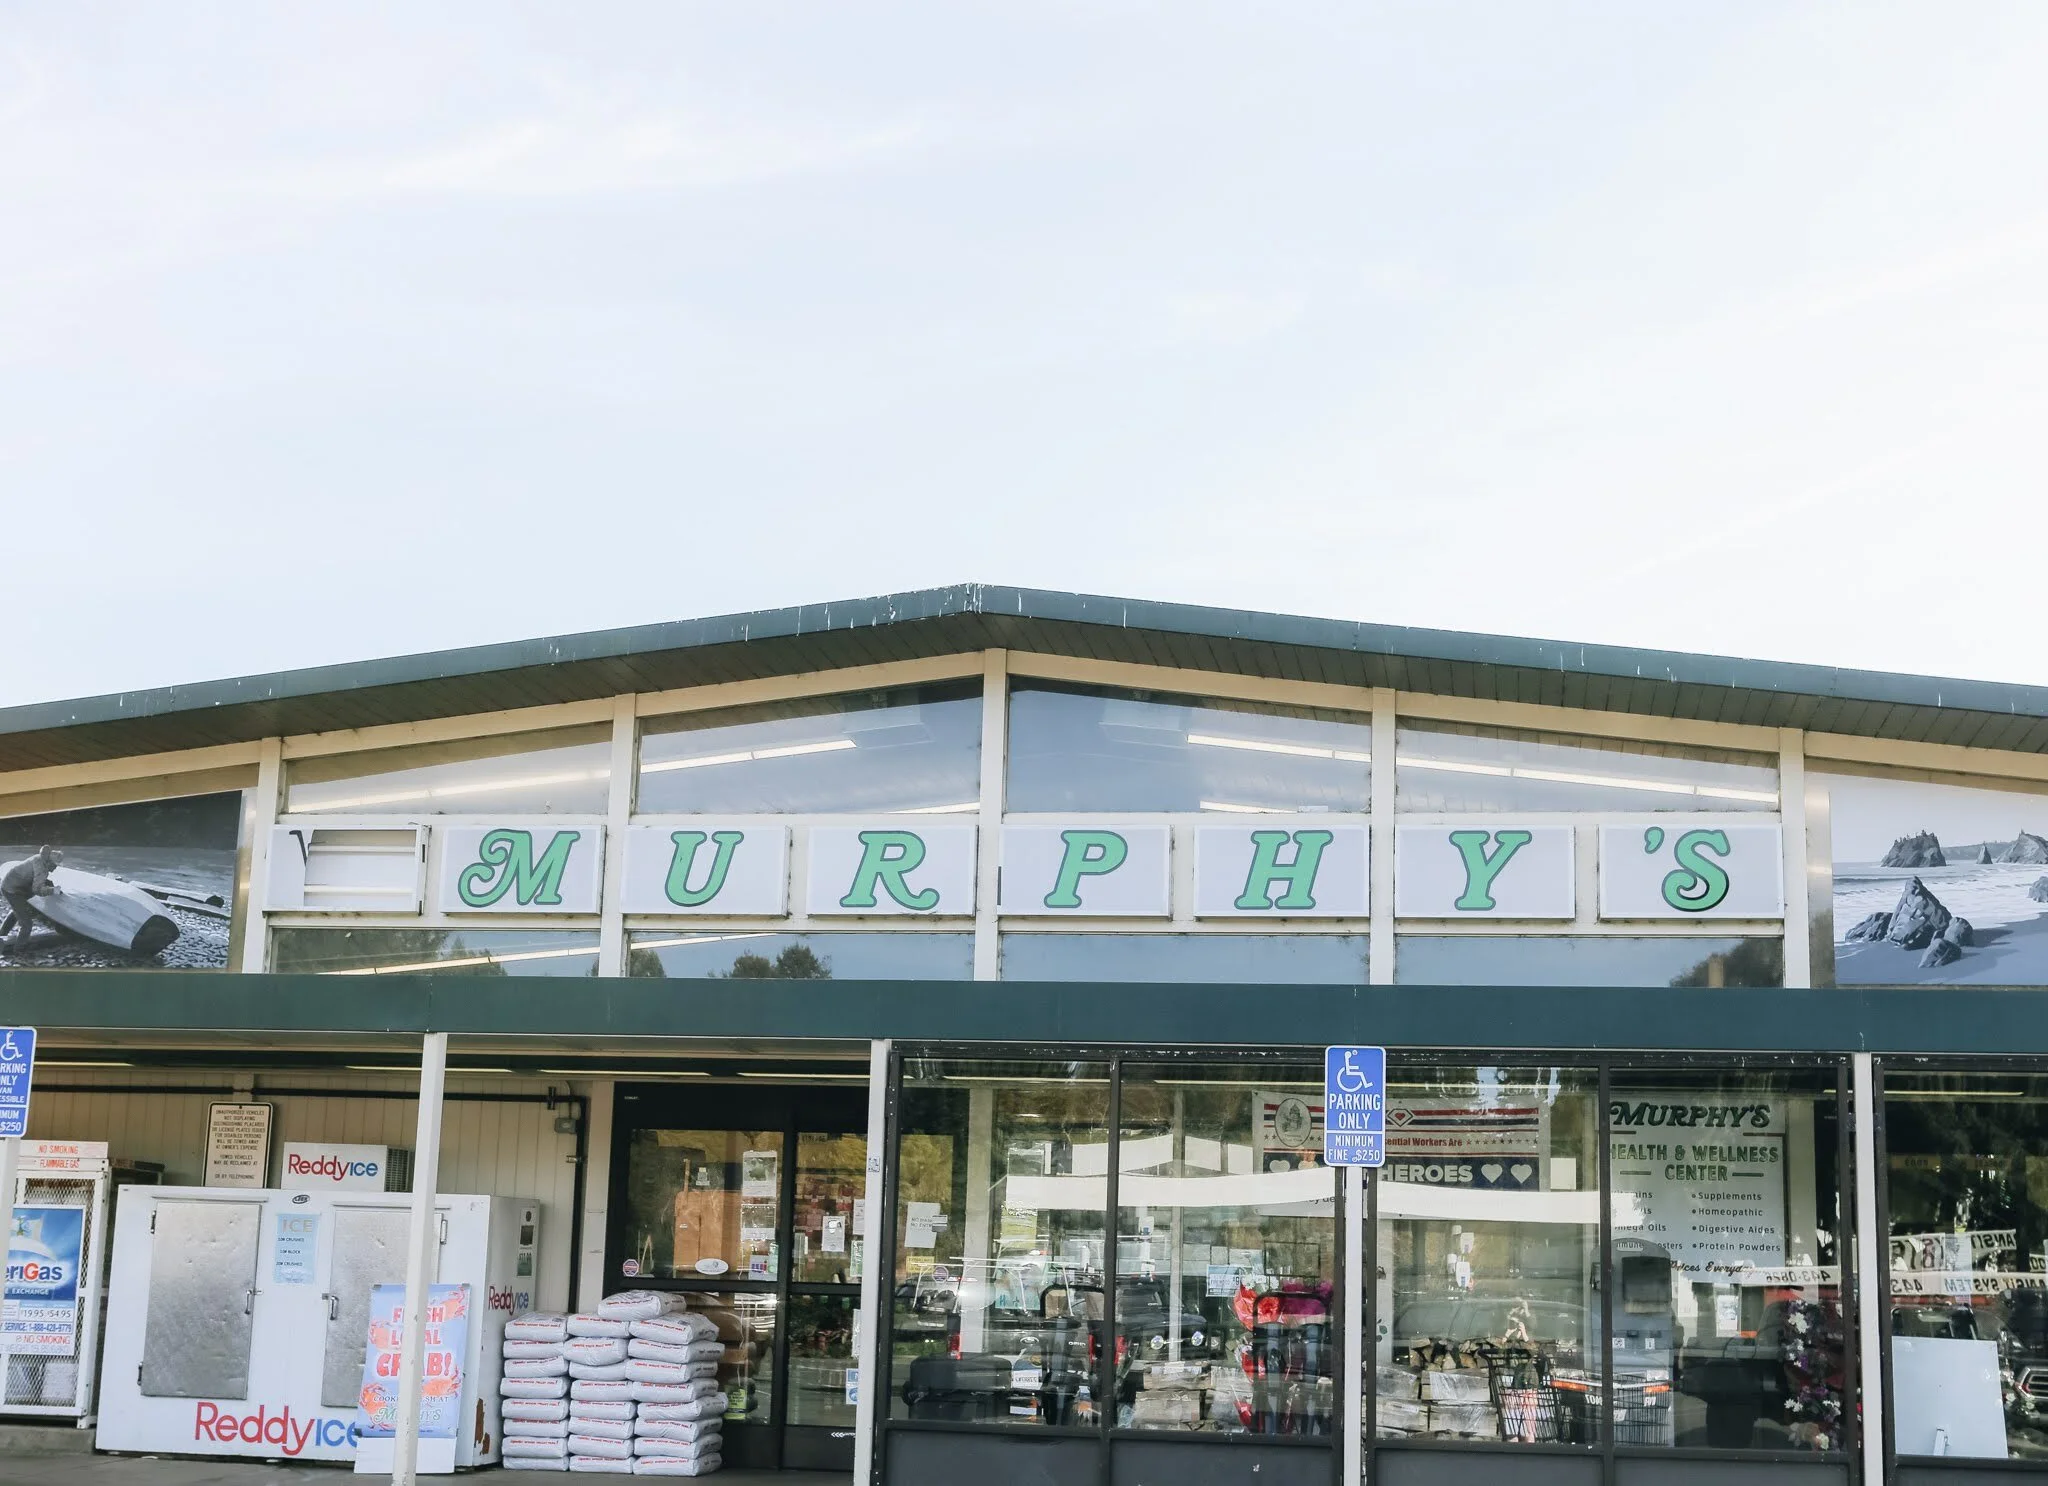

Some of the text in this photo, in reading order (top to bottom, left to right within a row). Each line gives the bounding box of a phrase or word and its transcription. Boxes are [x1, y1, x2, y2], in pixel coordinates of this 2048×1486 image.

[458, 827, 1732, 913] MURPHY'S
[0, 1075, 17, 1086] NLY
[1329, 1093, 1381, 1111] PARKING
[1338, 1112, 1371, 1129] ONLY
[1610, 1101, 1771, 1128] MURPHY'S
[1335, 1135, 1374, 1148] MINIMUM
[1412, 1138, 1447, 1147] Workers
[1448, 1138, 1463, 1147] Are
[50, 1145, 79, 1155] SMOKING
[1328, 1148, 1380, 1162] FINE $250
[1675, 1144, 1686, 1161] &
[1691, 1145, 1779, 1163] WELLNESS
[70, 1160, 80, 1169] GAS
[1377, 1164, 1474, 1183] HEROES
[1664, 1164, 1728, 1181] CENTER
[1698, 1191, 1762, 1201] Supplements
[1698, 1207, 1764, 1218] Homeopathic
[282, 1218, 313, 1233] ICE
[1648, 1223, 1667, 1232] Oils
[1699, 1224, 1775, 1235] Digestive Aides
[1699, 1242, 1781, 1252] Protein Powders
[12, 1288, 49, 1296] EXCHANGE
[392, 1307, 445, 1323] FSH
[36, 1335, 70, 1345] SMOKING
[390, 1329, 442, 1346] LAL
